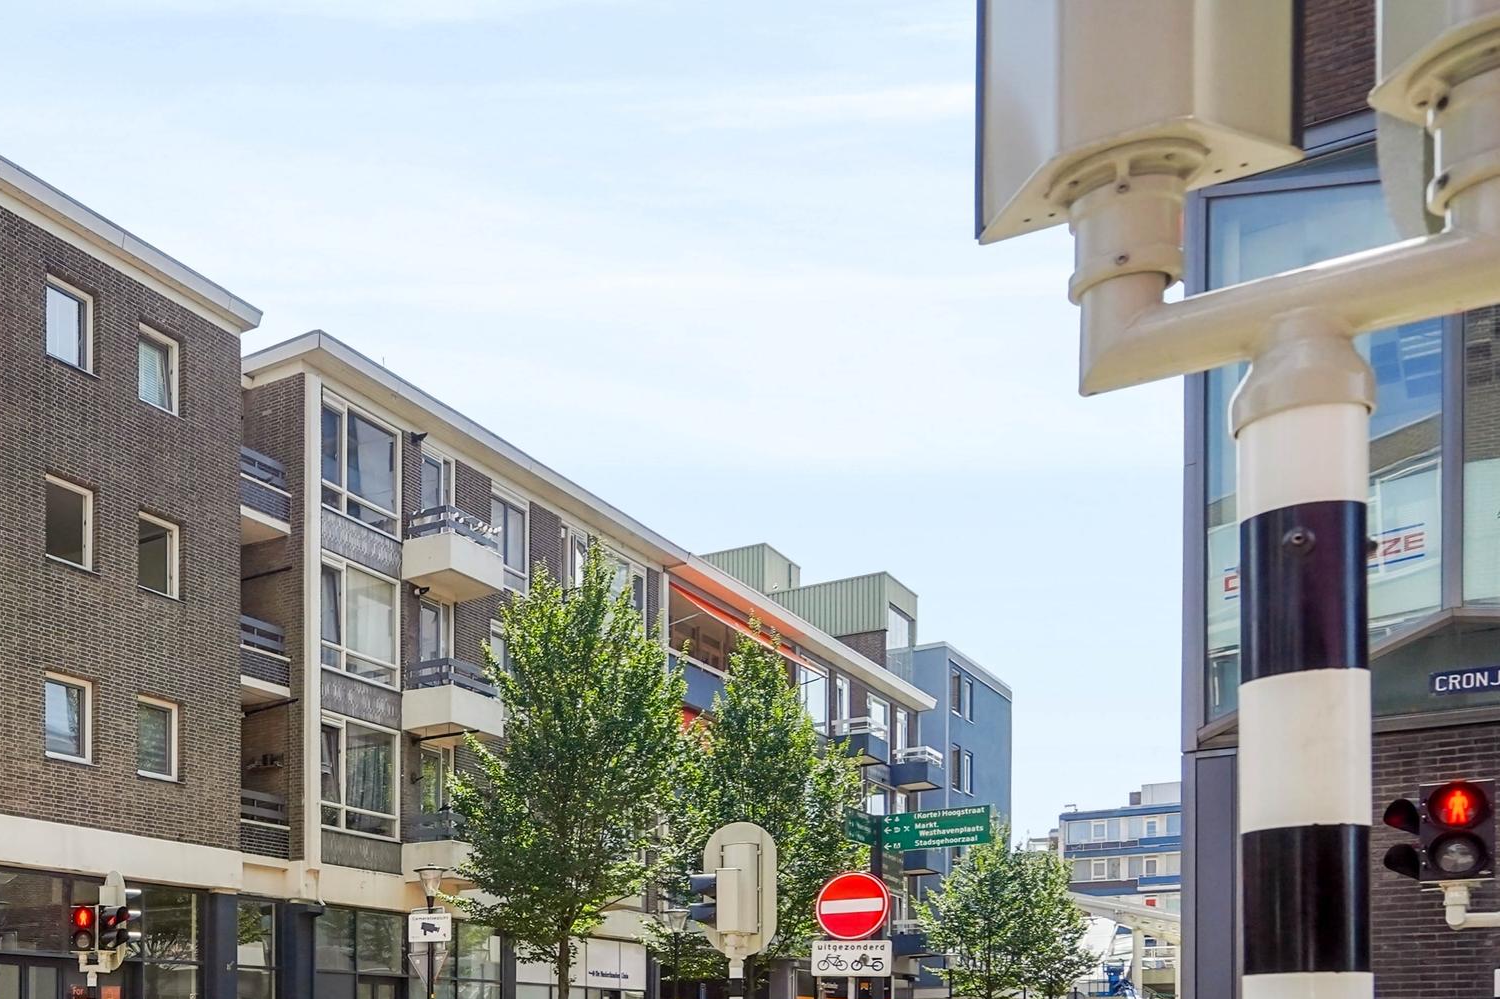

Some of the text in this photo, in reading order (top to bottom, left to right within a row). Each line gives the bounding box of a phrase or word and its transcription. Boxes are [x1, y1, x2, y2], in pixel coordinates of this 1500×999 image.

[913, 806, 985, 820] (Korte) Hoogstraat
[919, 825, 984, 837] Westhavenplaats
[914, 834, 978, 847] Stadsgehoorzaal
[817, 943, 885, 952] uitgezonderd
[72, 986, 85, 996] For
